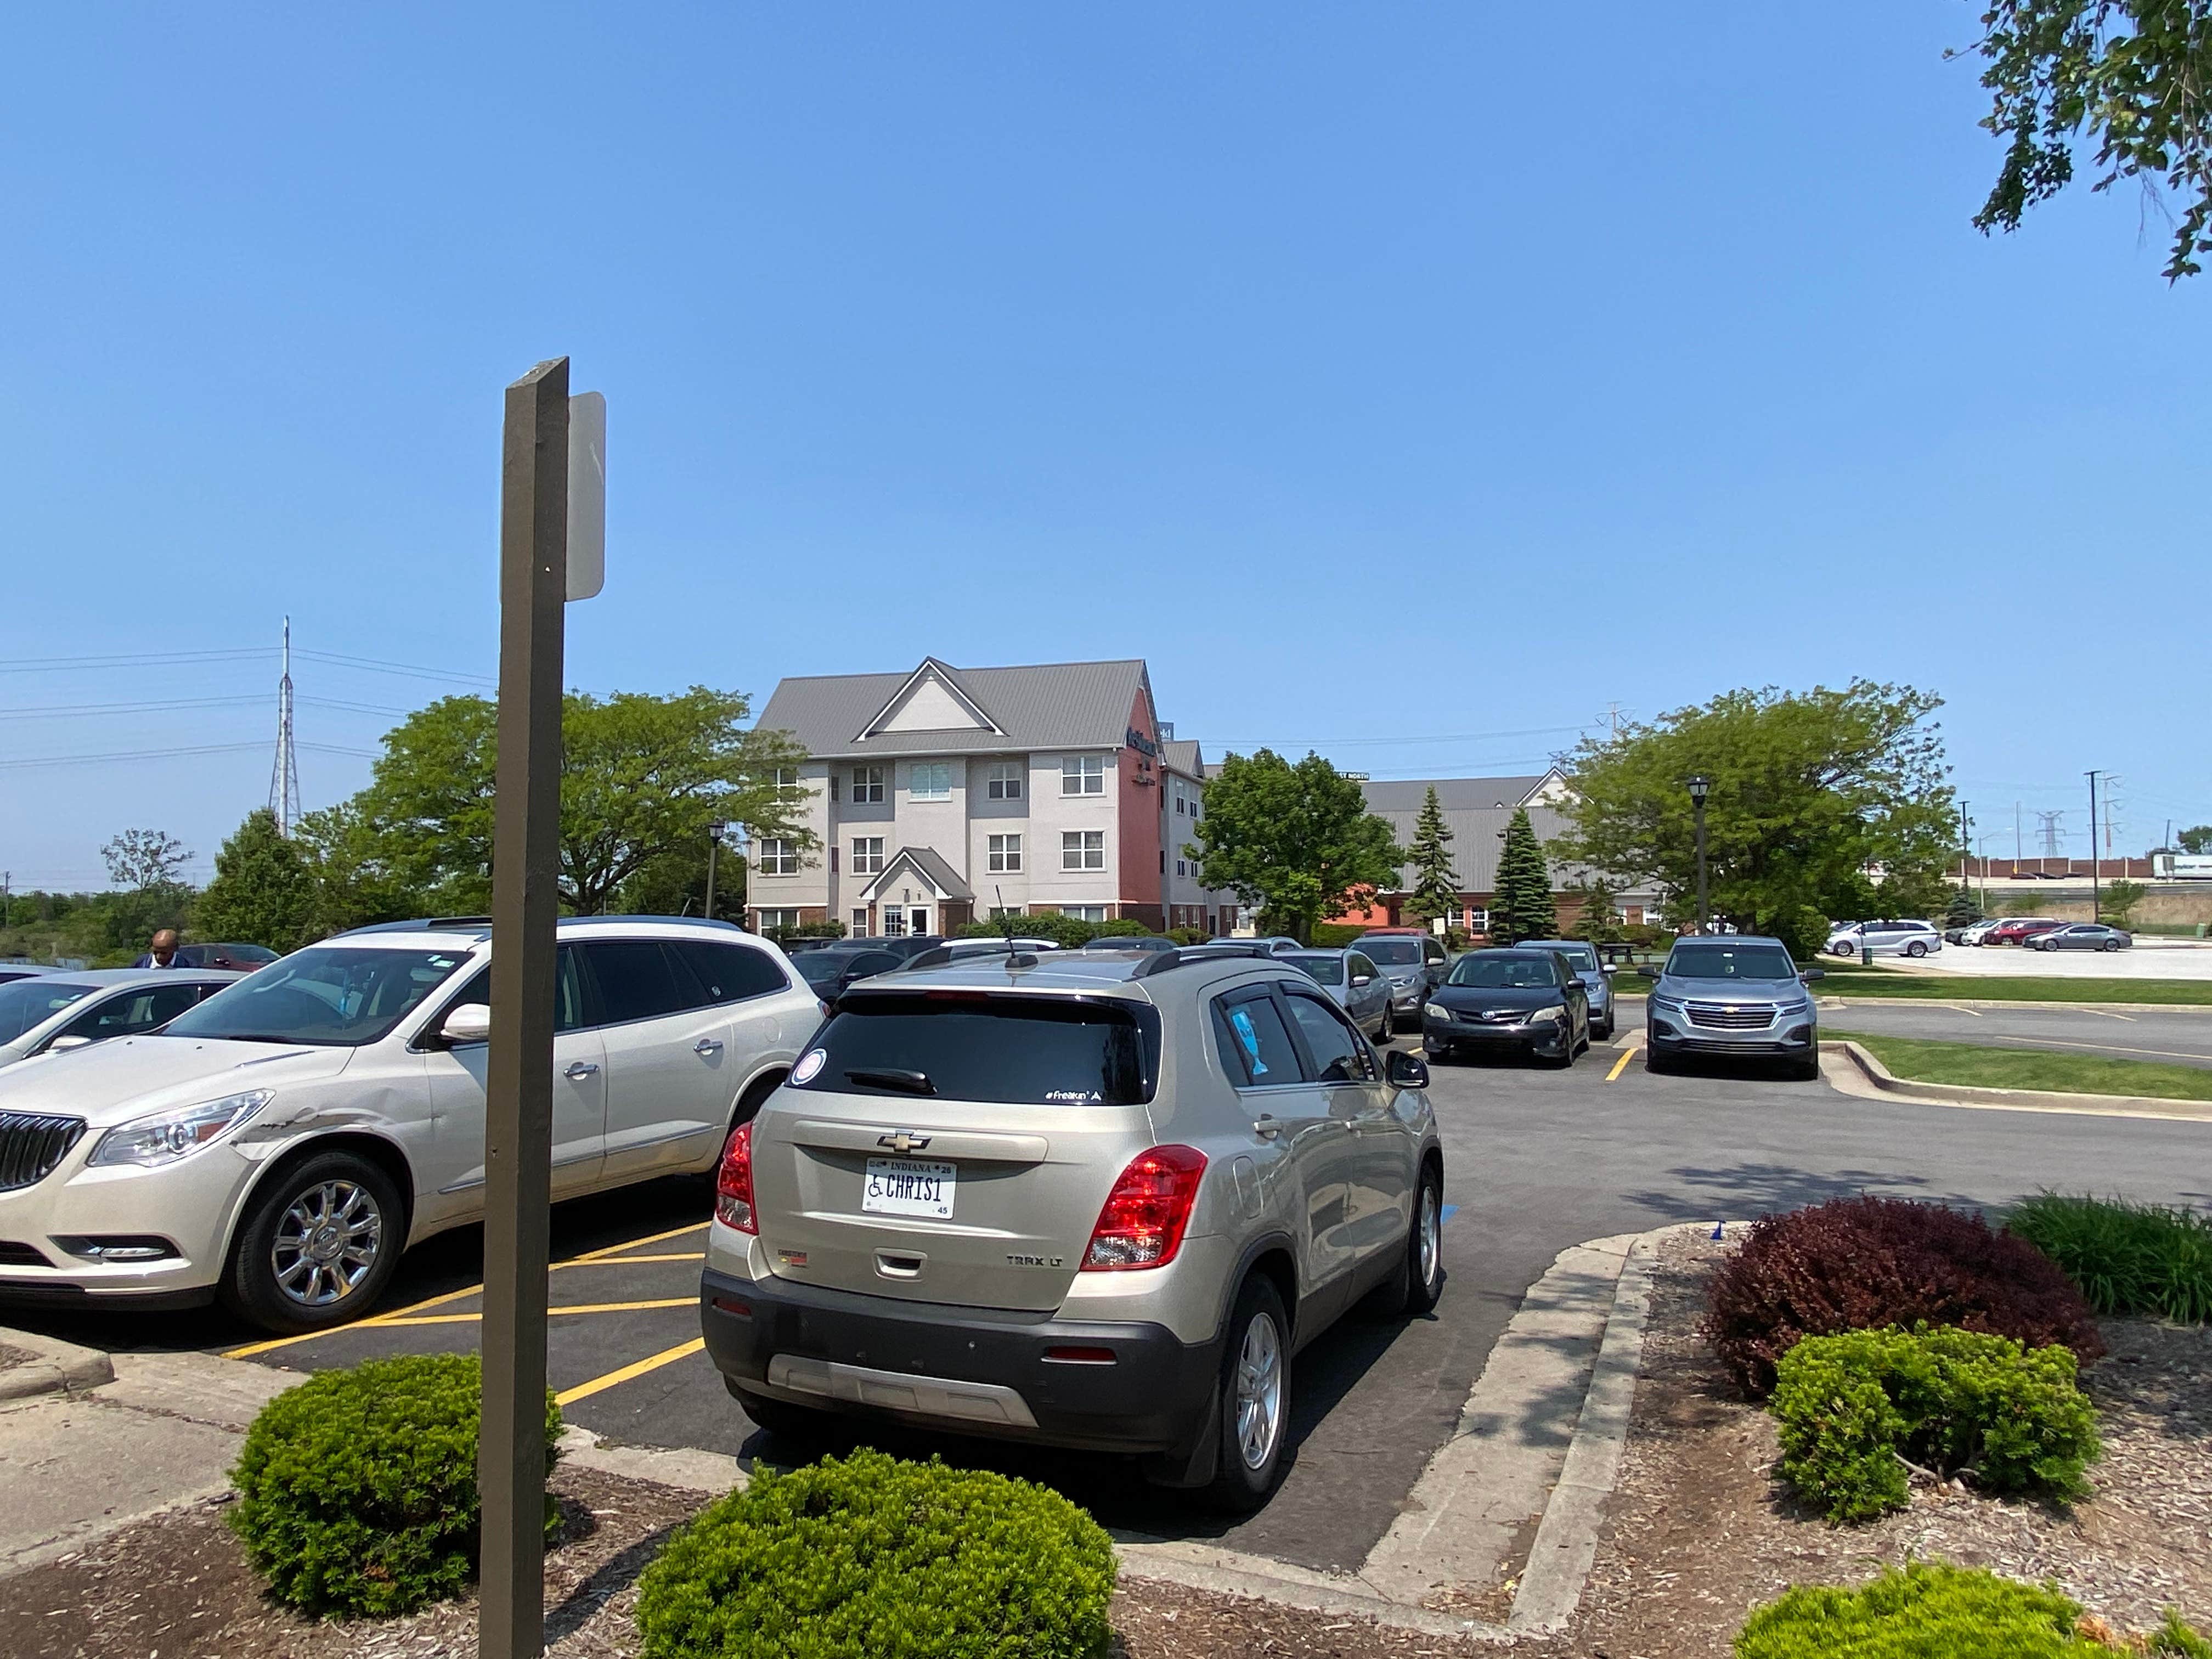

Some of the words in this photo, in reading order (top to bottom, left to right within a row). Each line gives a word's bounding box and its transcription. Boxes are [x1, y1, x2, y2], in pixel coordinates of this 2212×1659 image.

[891, 1161, 931, 1172] INDIANA
[887, 1174, 941, 1202] CHRIS1
[1007, 1256, 1044, 1266] TRAX
[1050, 1259, 1062, 1267] LT
